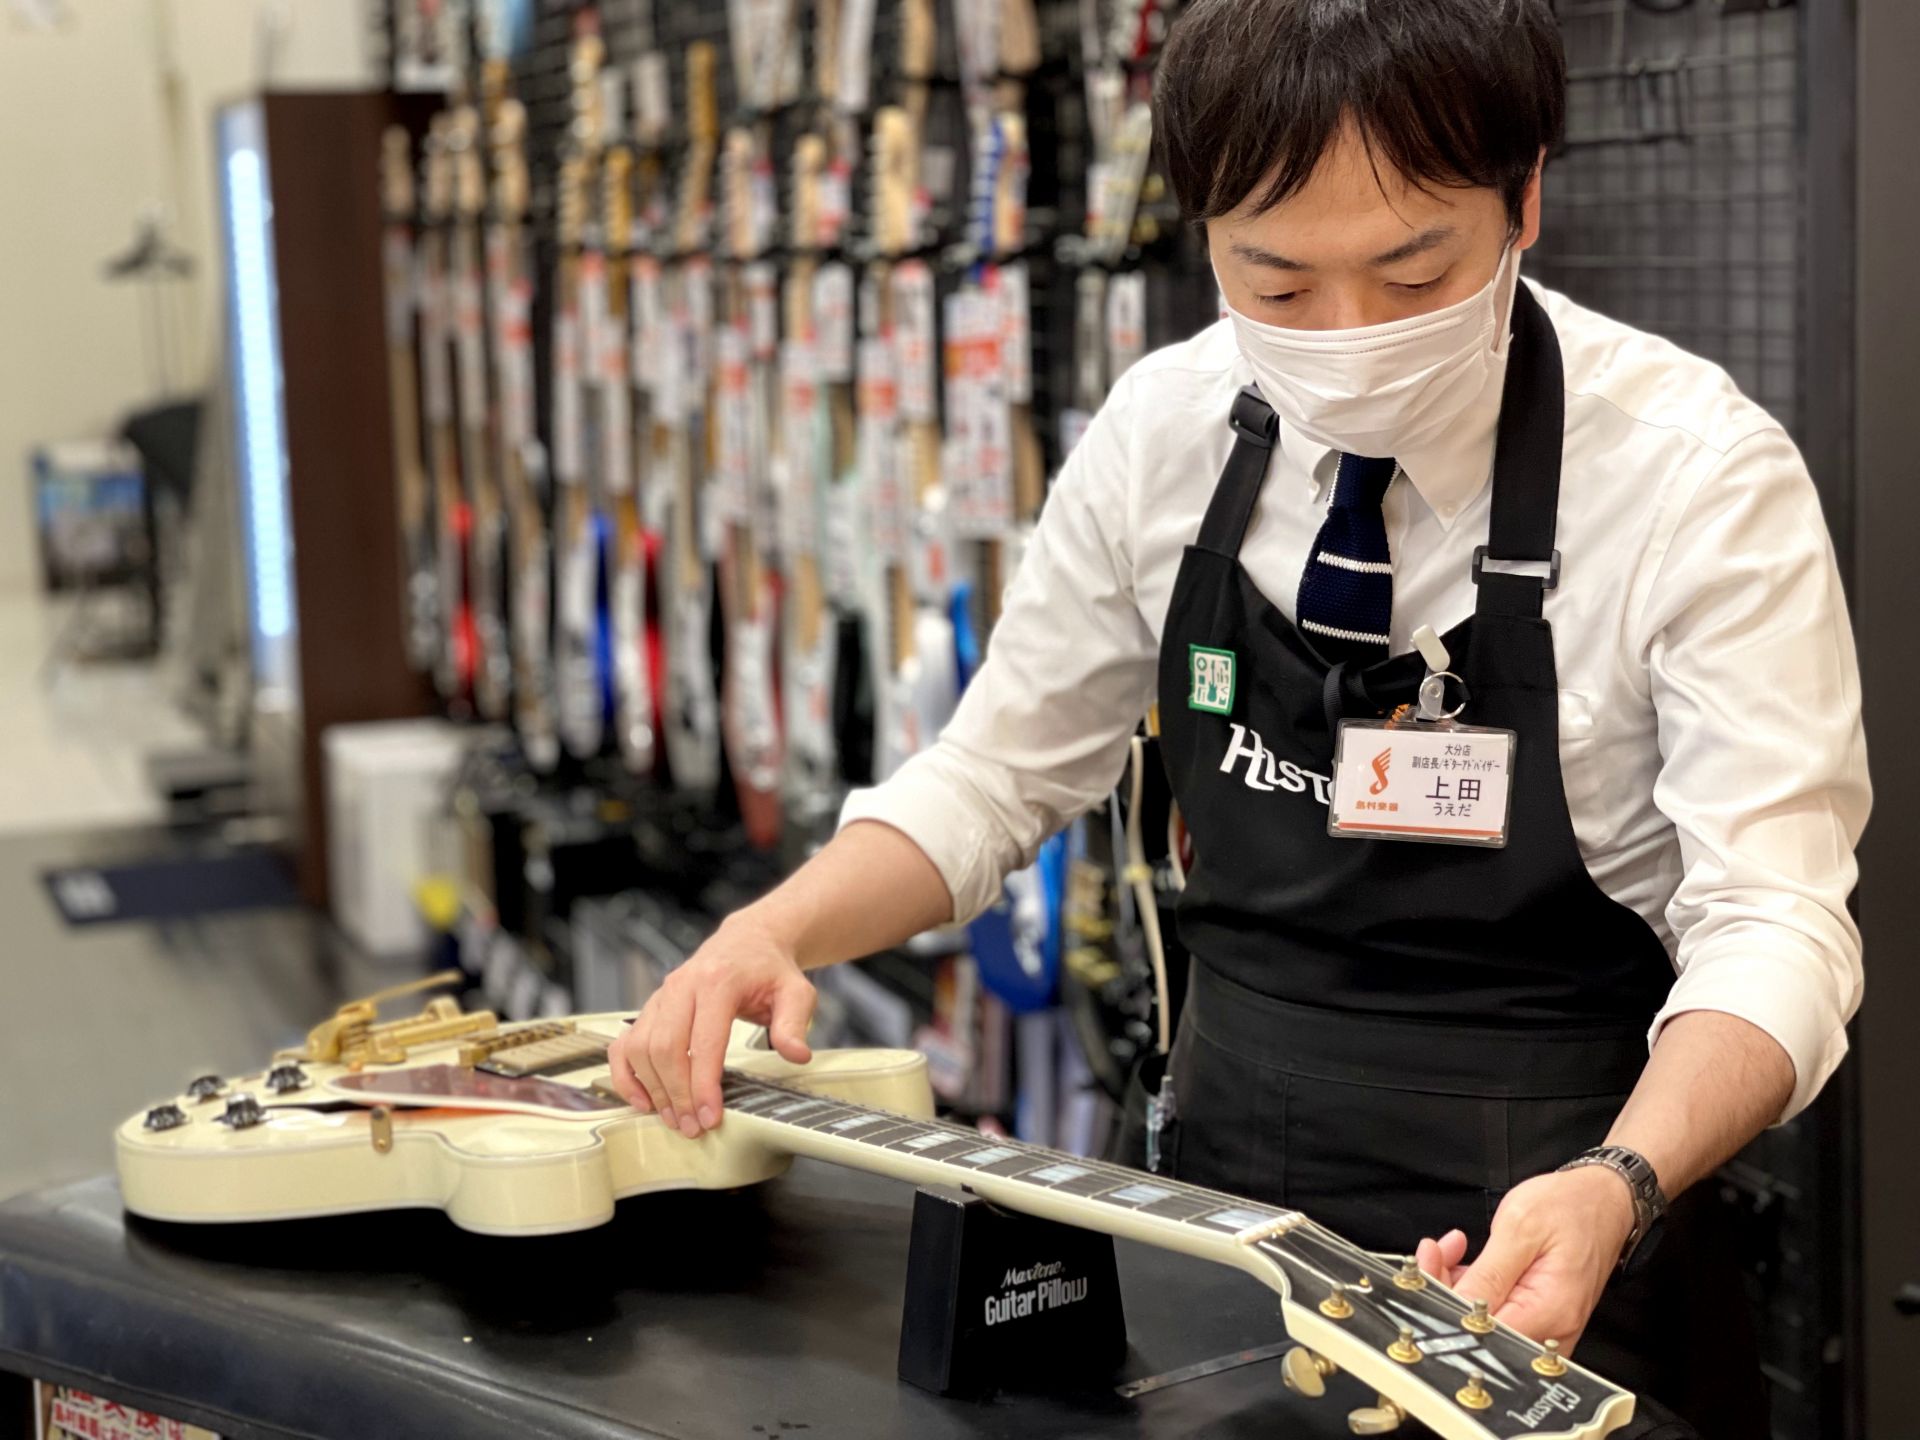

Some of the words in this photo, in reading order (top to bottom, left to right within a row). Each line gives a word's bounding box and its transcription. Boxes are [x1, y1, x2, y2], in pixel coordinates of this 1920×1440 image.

[1219, 723, 1334, 805] HIST
[1444, 744, 1472, 757] 大分店
[1425, 776, 1481, 801] 上田
[1432, 802, 1472, 817] うえだ
[984, 1289, 1036, 1326] Guitar
[1037, 1276, 1088, 1312] Pillow
[1506, 1379, 1581, 1429] Gibson
